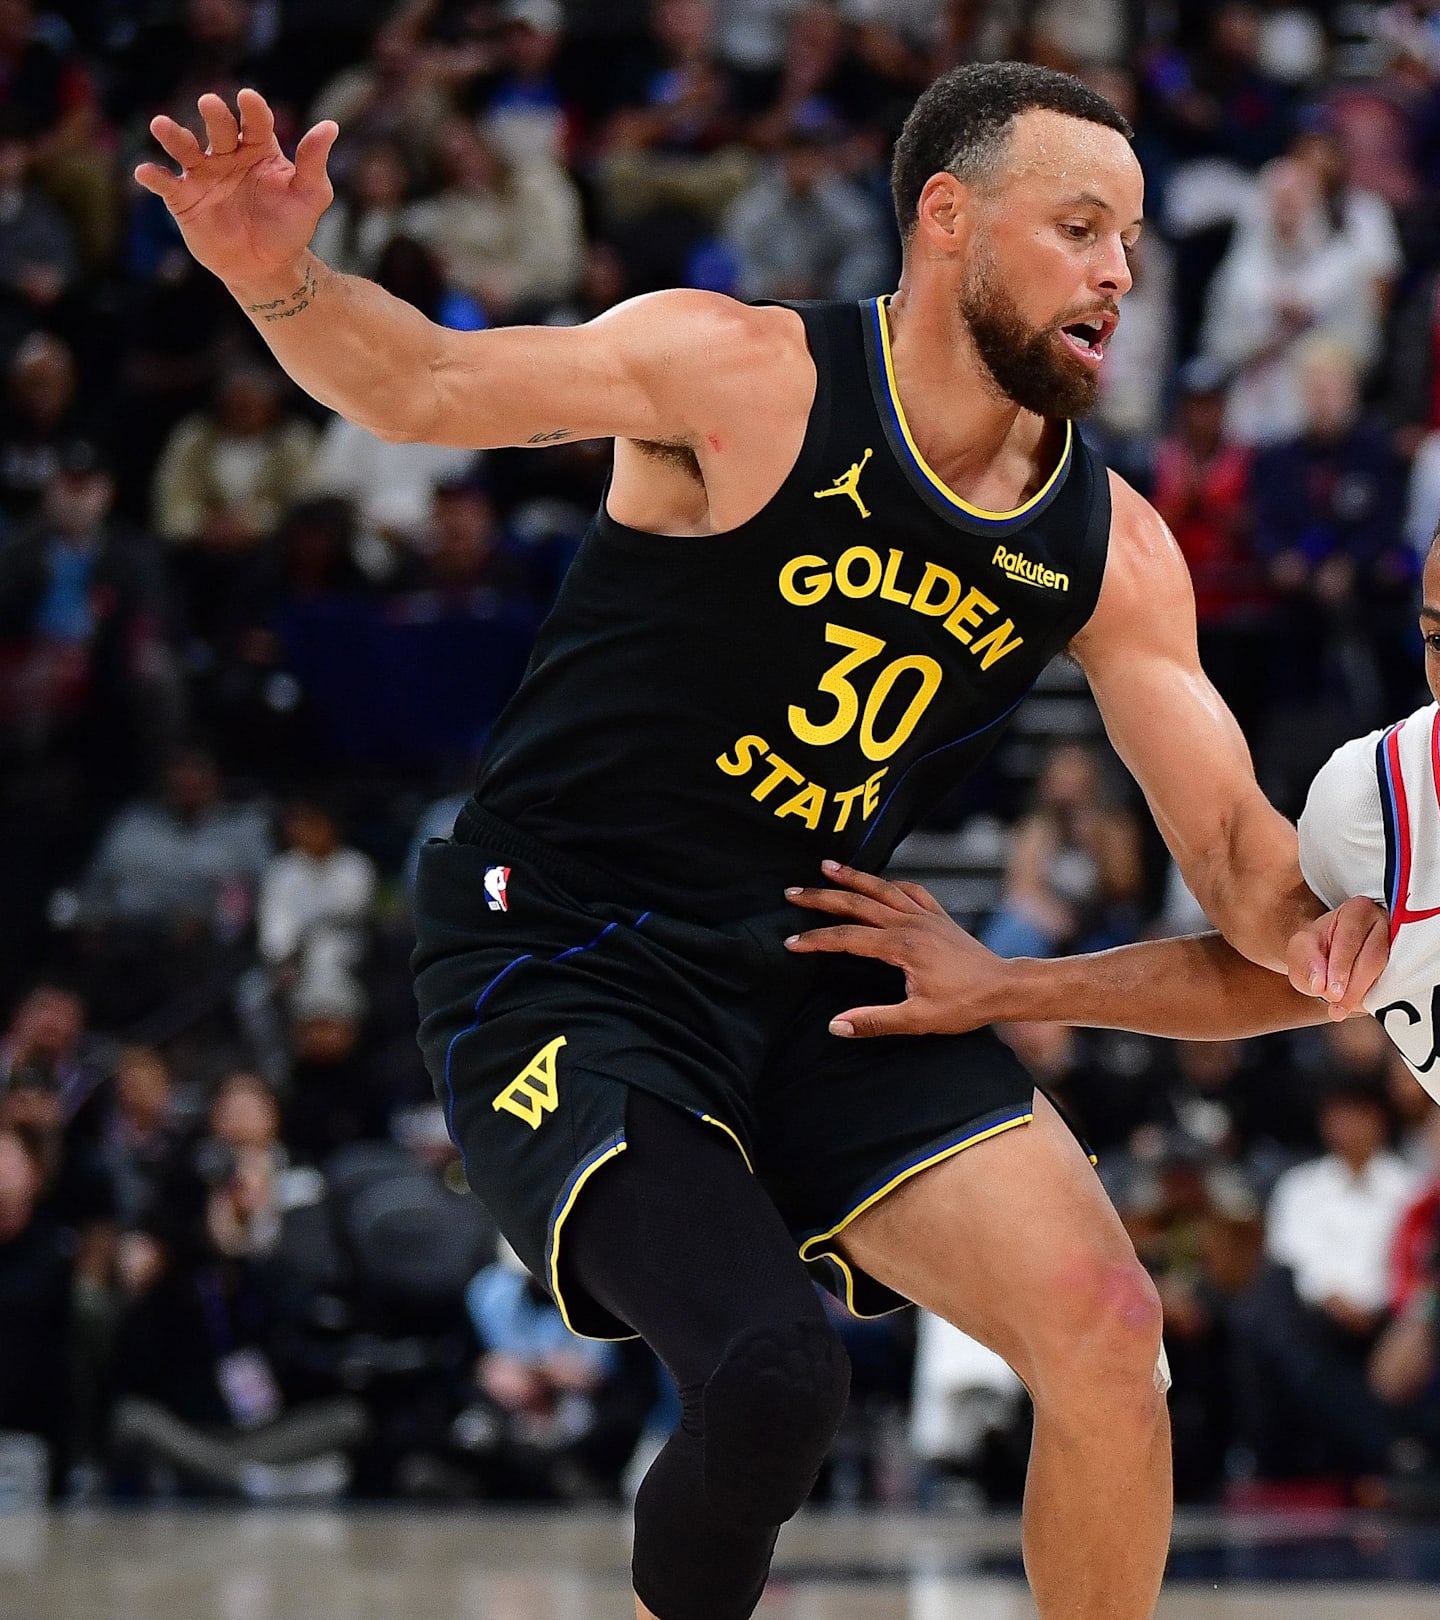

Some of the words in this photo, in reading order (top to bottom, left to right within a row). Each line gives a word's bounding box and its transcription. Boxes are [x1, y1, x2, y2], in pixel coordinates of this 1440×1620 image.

[778, 545, 1024, 671] GOLDEN
[991, 545, 1069, 592] Rakuten
[787, 622, 943, 762] 30
[715, 734, 889, 833] STATE
